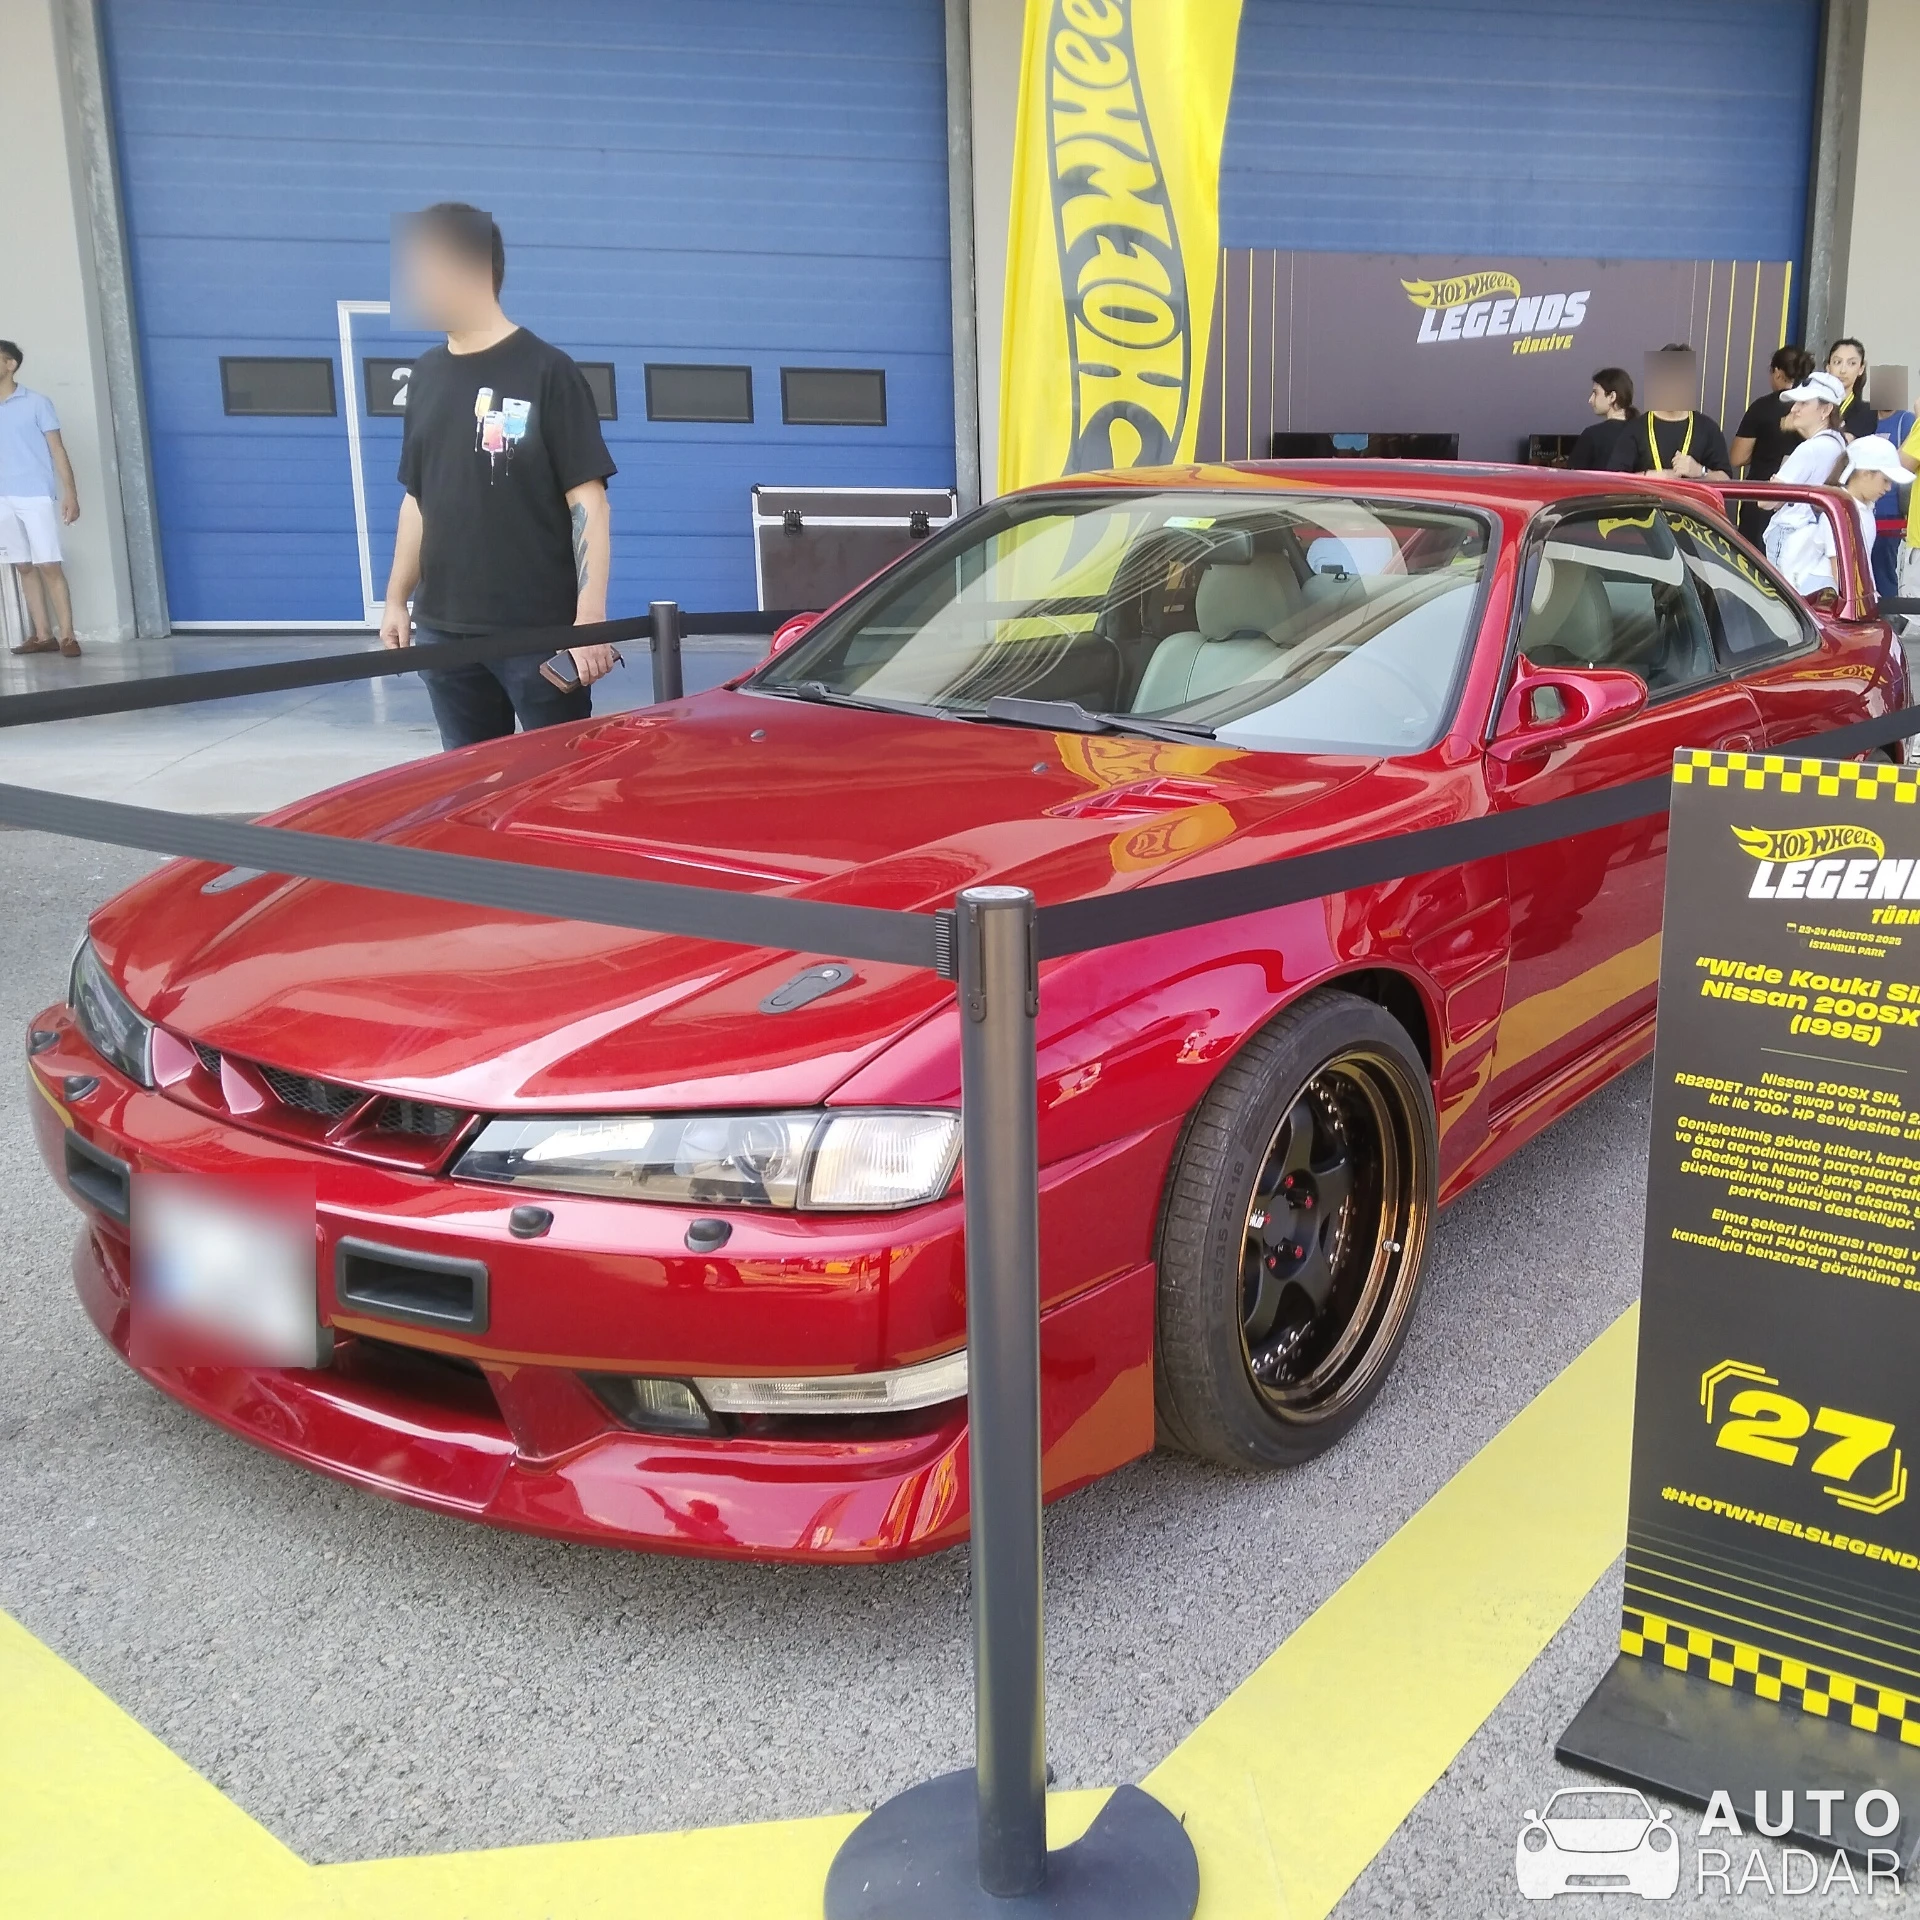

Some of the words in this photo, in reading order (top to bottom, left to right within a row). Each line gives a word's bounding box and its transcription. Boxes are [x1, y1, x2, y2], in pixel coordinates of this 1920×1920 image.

[1416, 290, 1592, 344] LEGENDS
[391, 367, 412, 406] 2
[1809, 939, 1856, 954] İSTANBUL
[1858, 946, 1886, 957] PARK
[1828, 928, 1875, 942] AĞUSTOS
[1875, 934, 1902, 945] 2025
[1701, 980, 1808, 1010] Nissan
[1813, 996, 1920, 1027] 200SX
[1789, 970, 1882, 998] Kouki
[1887, 983, 1920, 1005] Si
[1790, 1014, 1882, 1047] (1995)
[1744, 1085, 1792, 1103] motor
[1793, 1094, 1835, 1111] swap
[1838, 1101, 1856, 1114] ve
[1860, 1103, 1907, 1123] Tomei
[1761, 1072, 1814, 1092] Nissan
[1816, 1081, 1870, 1101] 200SX
[1708, 1092, 1730, 1107] kit
[1731, 1097, 1750, 1111] ile
[1753, 1100, 1789, 1116] 700+
[1791, 1107, 1815, 1121] HP
[1816, 1113, 1901, 1137] seviyesine
[1675, 1131, 1692, 1143] ve
[1694, 1133, 1725, 1149] özel
[1727, 1141, 1822, 1167] aerodinamik
[1823, 1159, 1907, 1184] parçalarla
[1677, 1116, 1773, 1145] Genişletilmiş
[1774, 1134, 1822, 1153] gövde
[1823, 1142, 1873, 1163] kitleri,
[1231, 1161, 1245, 1185] 18
[1680, 1160, 1785, 1192] güçlendirilmiş
[1786, 1181, 1852, 1203] yürüyen
[1854, 1194, 1911, 1216] aksam,
[1691, 1147, 1749, 1170] GReddy
[1751, 1160, 1769, 1172] ve
[1771, 1162, 1820, 1181] Nismo
[1821, 1173, 1863, 1192] yarış
[1728, 1184, 1822, 1212] performansı
[1824, 1203, 1916, 1231] destekliyor.
[1671, 1227, 1744, 1254] kanadıyla
[1745, 1243, 1820, 1270] benzersiz
[1820, 1260, 1901, 1287] görünüme
[1711, 1207, 1749, 1226] Elma
[1750, 1217, 1797, 1236] şekeri
[1799, 1226, 1865, 1250] kırmızısı
[1867, 1241, 1909, 1260] rengi
[1721, 1224, 1773, 1246] Ferrari
[1775, 1235, 1838, 1259] F40'dan
[1840, 1250, 1916, 1276] esinlenen
[1715, 1389, 1896, 1482] 27
[1661, 1486, 1920, 1573] #HOTWHEELSLEGEND
